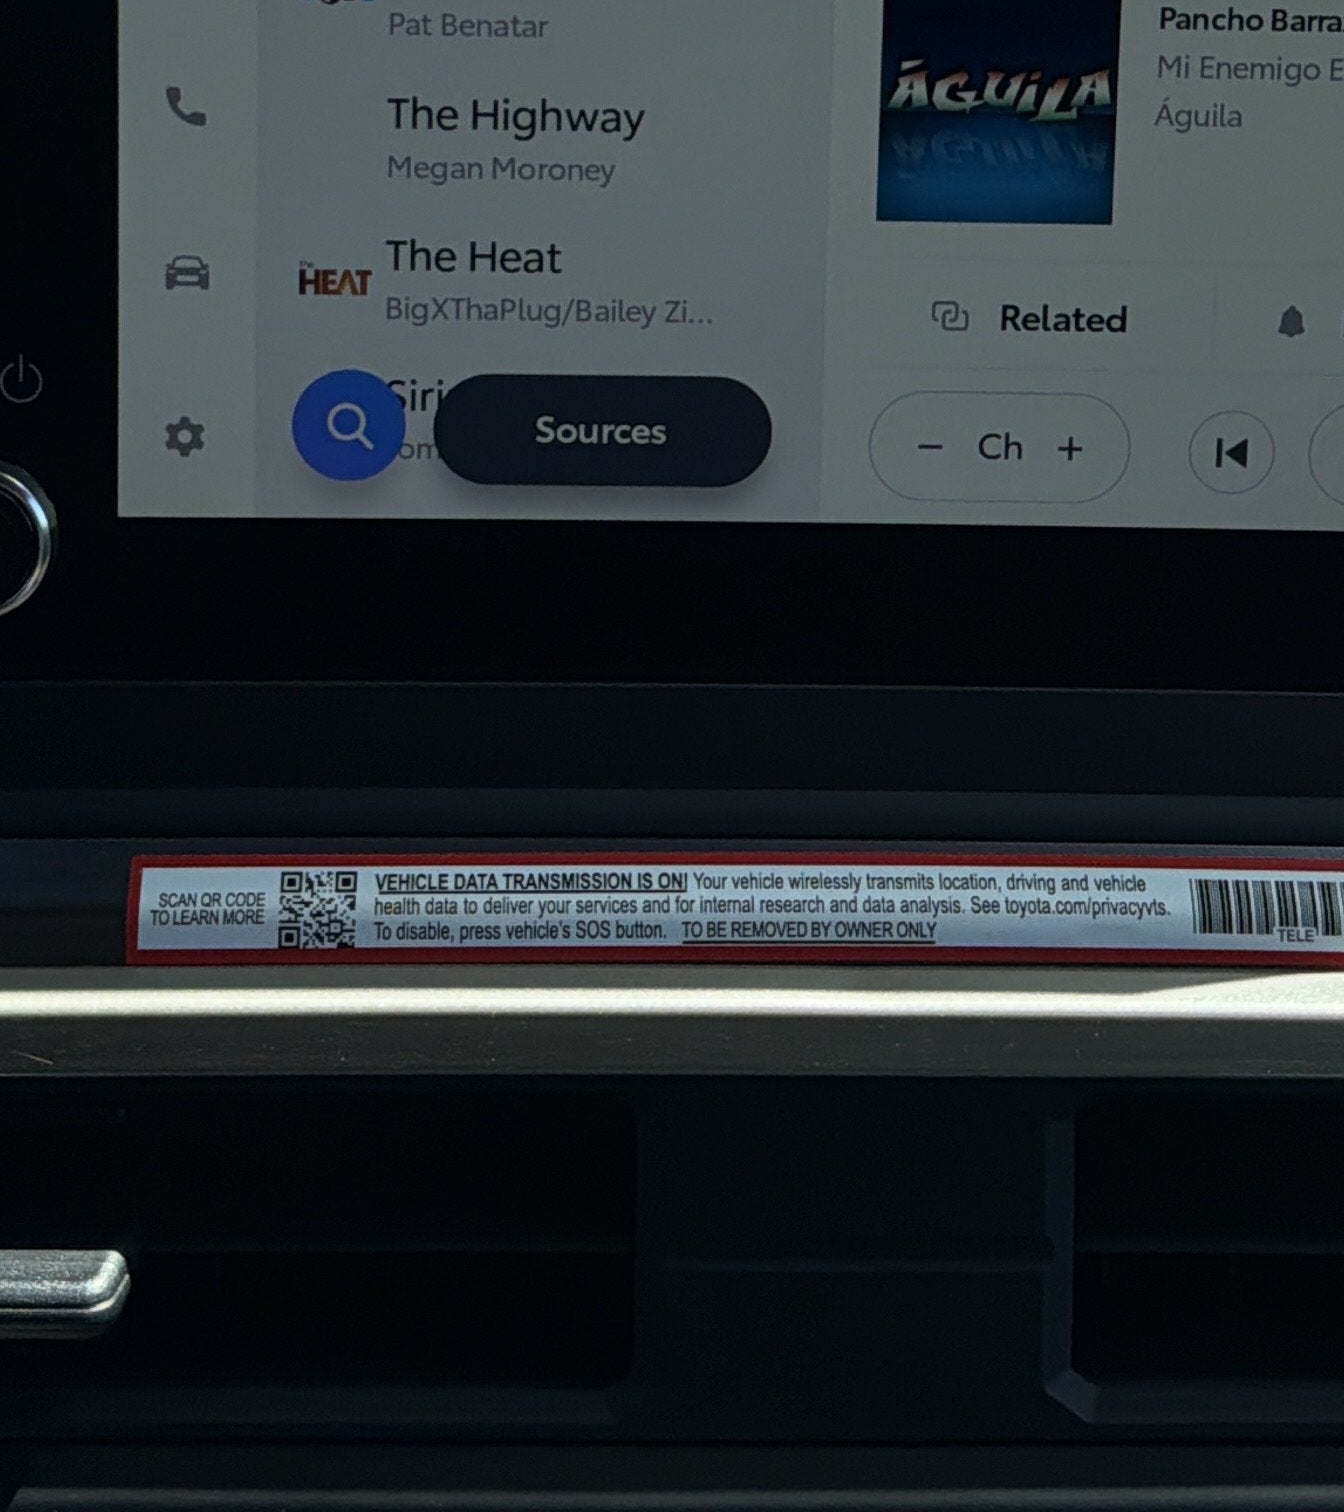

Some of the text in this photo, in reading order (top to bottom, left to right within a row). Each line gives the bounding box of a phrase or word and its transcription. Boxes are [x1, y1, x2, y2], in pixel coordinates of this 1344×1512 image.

[388, 12, 550, 39] Pat Benatar
[1159, 6, 1265, 33] Pancho
[1157, 54, 1191, 80] Mi
[1199, 56, 1322, 88] Enemigo
[386, 96, 646, 142] The Highway
[1153, 97, 1243, 133] Águila
[387, 155, 617, 189] Megan Moroney
[386, 238, 563, 275] The Heat
[299, 269, 373, 296] HEAT
[385, 297, 657, 330] BigXThaPlug/Bailey
[999, 303, 1128, 334] Related
[534, 416, 667, 445] Sources
[978, 432, 1023, 461] Ch
[374, 873, 449, 892] VEHICLE
[456, 873, 499, 892] DATA
[503, 872, 633, 891] TRANSMISSION
[637, 872, 654, 890] IS
[692, 872, 727, 890] Your
[731, 872, 784, 890] vehicle
[787, 872, 862, 895] wirelessly
[865, 873, 935, 891] transmits
[938, 873, 1003, 893] location,
[1006, 874, 1056, 896] driving
[1060, 874, 1089, 892] and
[1092, 874, 1147, 893] vehicle
[158, 891, 267, 909] SCAN QR CODE
[374, 896, 421, 916] health
[424, 896, 458, 916] data
[463, 897, 478, 916] to
[482, 896, 533, 915] deliver
[538, 900, 572, 919] your
[575, 896, 638, 915] services
[641, 895, 671, 914] and
[674, 895, 695, 914] for
[699, 895, 755, 914] internal
[759, 895, 825, 914] research
[829, 895, 858, 914] and
[862, 895, 896, 914] data
[899, 896, 966, 919] analysis.
[970, 895, 1001, 915] See
[150, 909, 265, 926] TO LEARN MORE
[681, 921, 938, 940] TO BE REMOVED BY OWNER ONLY
[373, 920, 668, 944] To disable, press vehicle's SOS button.
[1276, 928, 1315, 943] TELE
